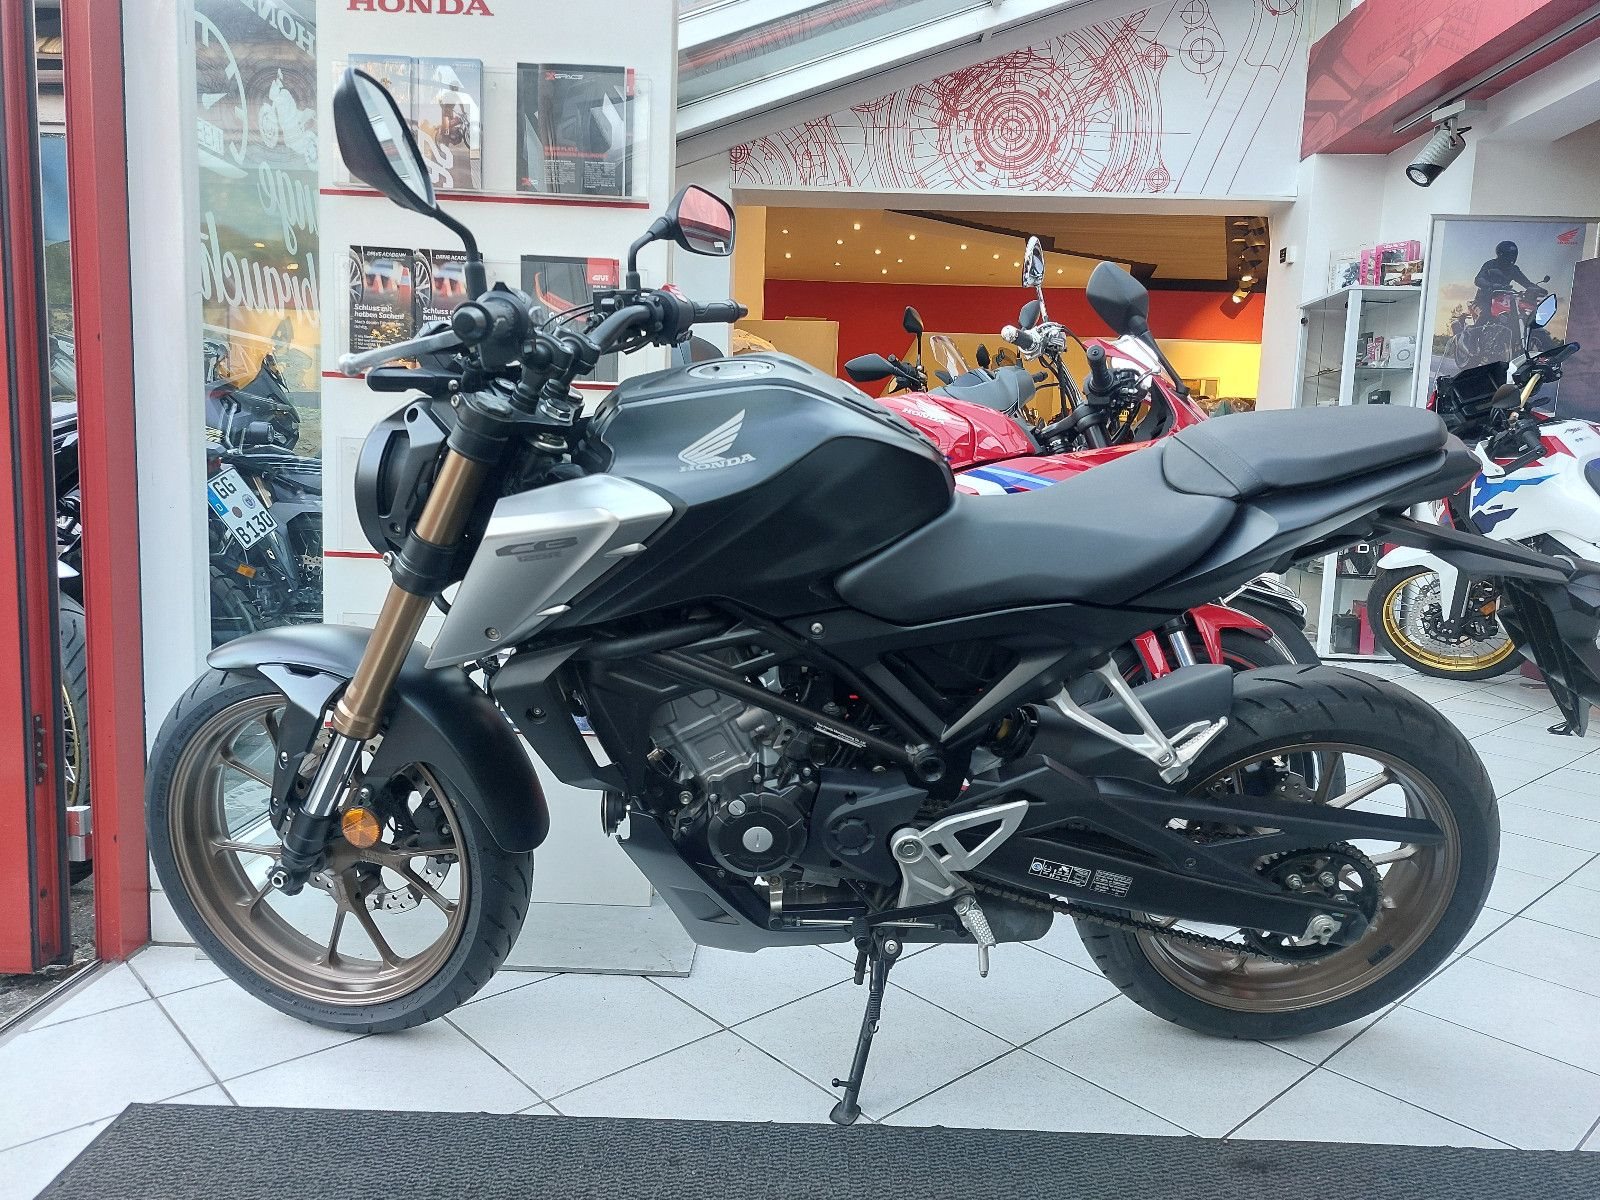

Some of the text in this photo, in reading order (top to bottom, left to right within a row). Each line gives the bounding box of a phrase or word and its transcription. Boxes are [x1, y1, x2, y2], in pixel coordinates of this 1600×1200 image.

[347, 0, 494, 16] HONDA
[354, 303, 379, 312] Schluss
[422, 307, 449, 315] Schluss
[679, 453, 757, 472] HONDA
[212, 476, 238, 499] GG
